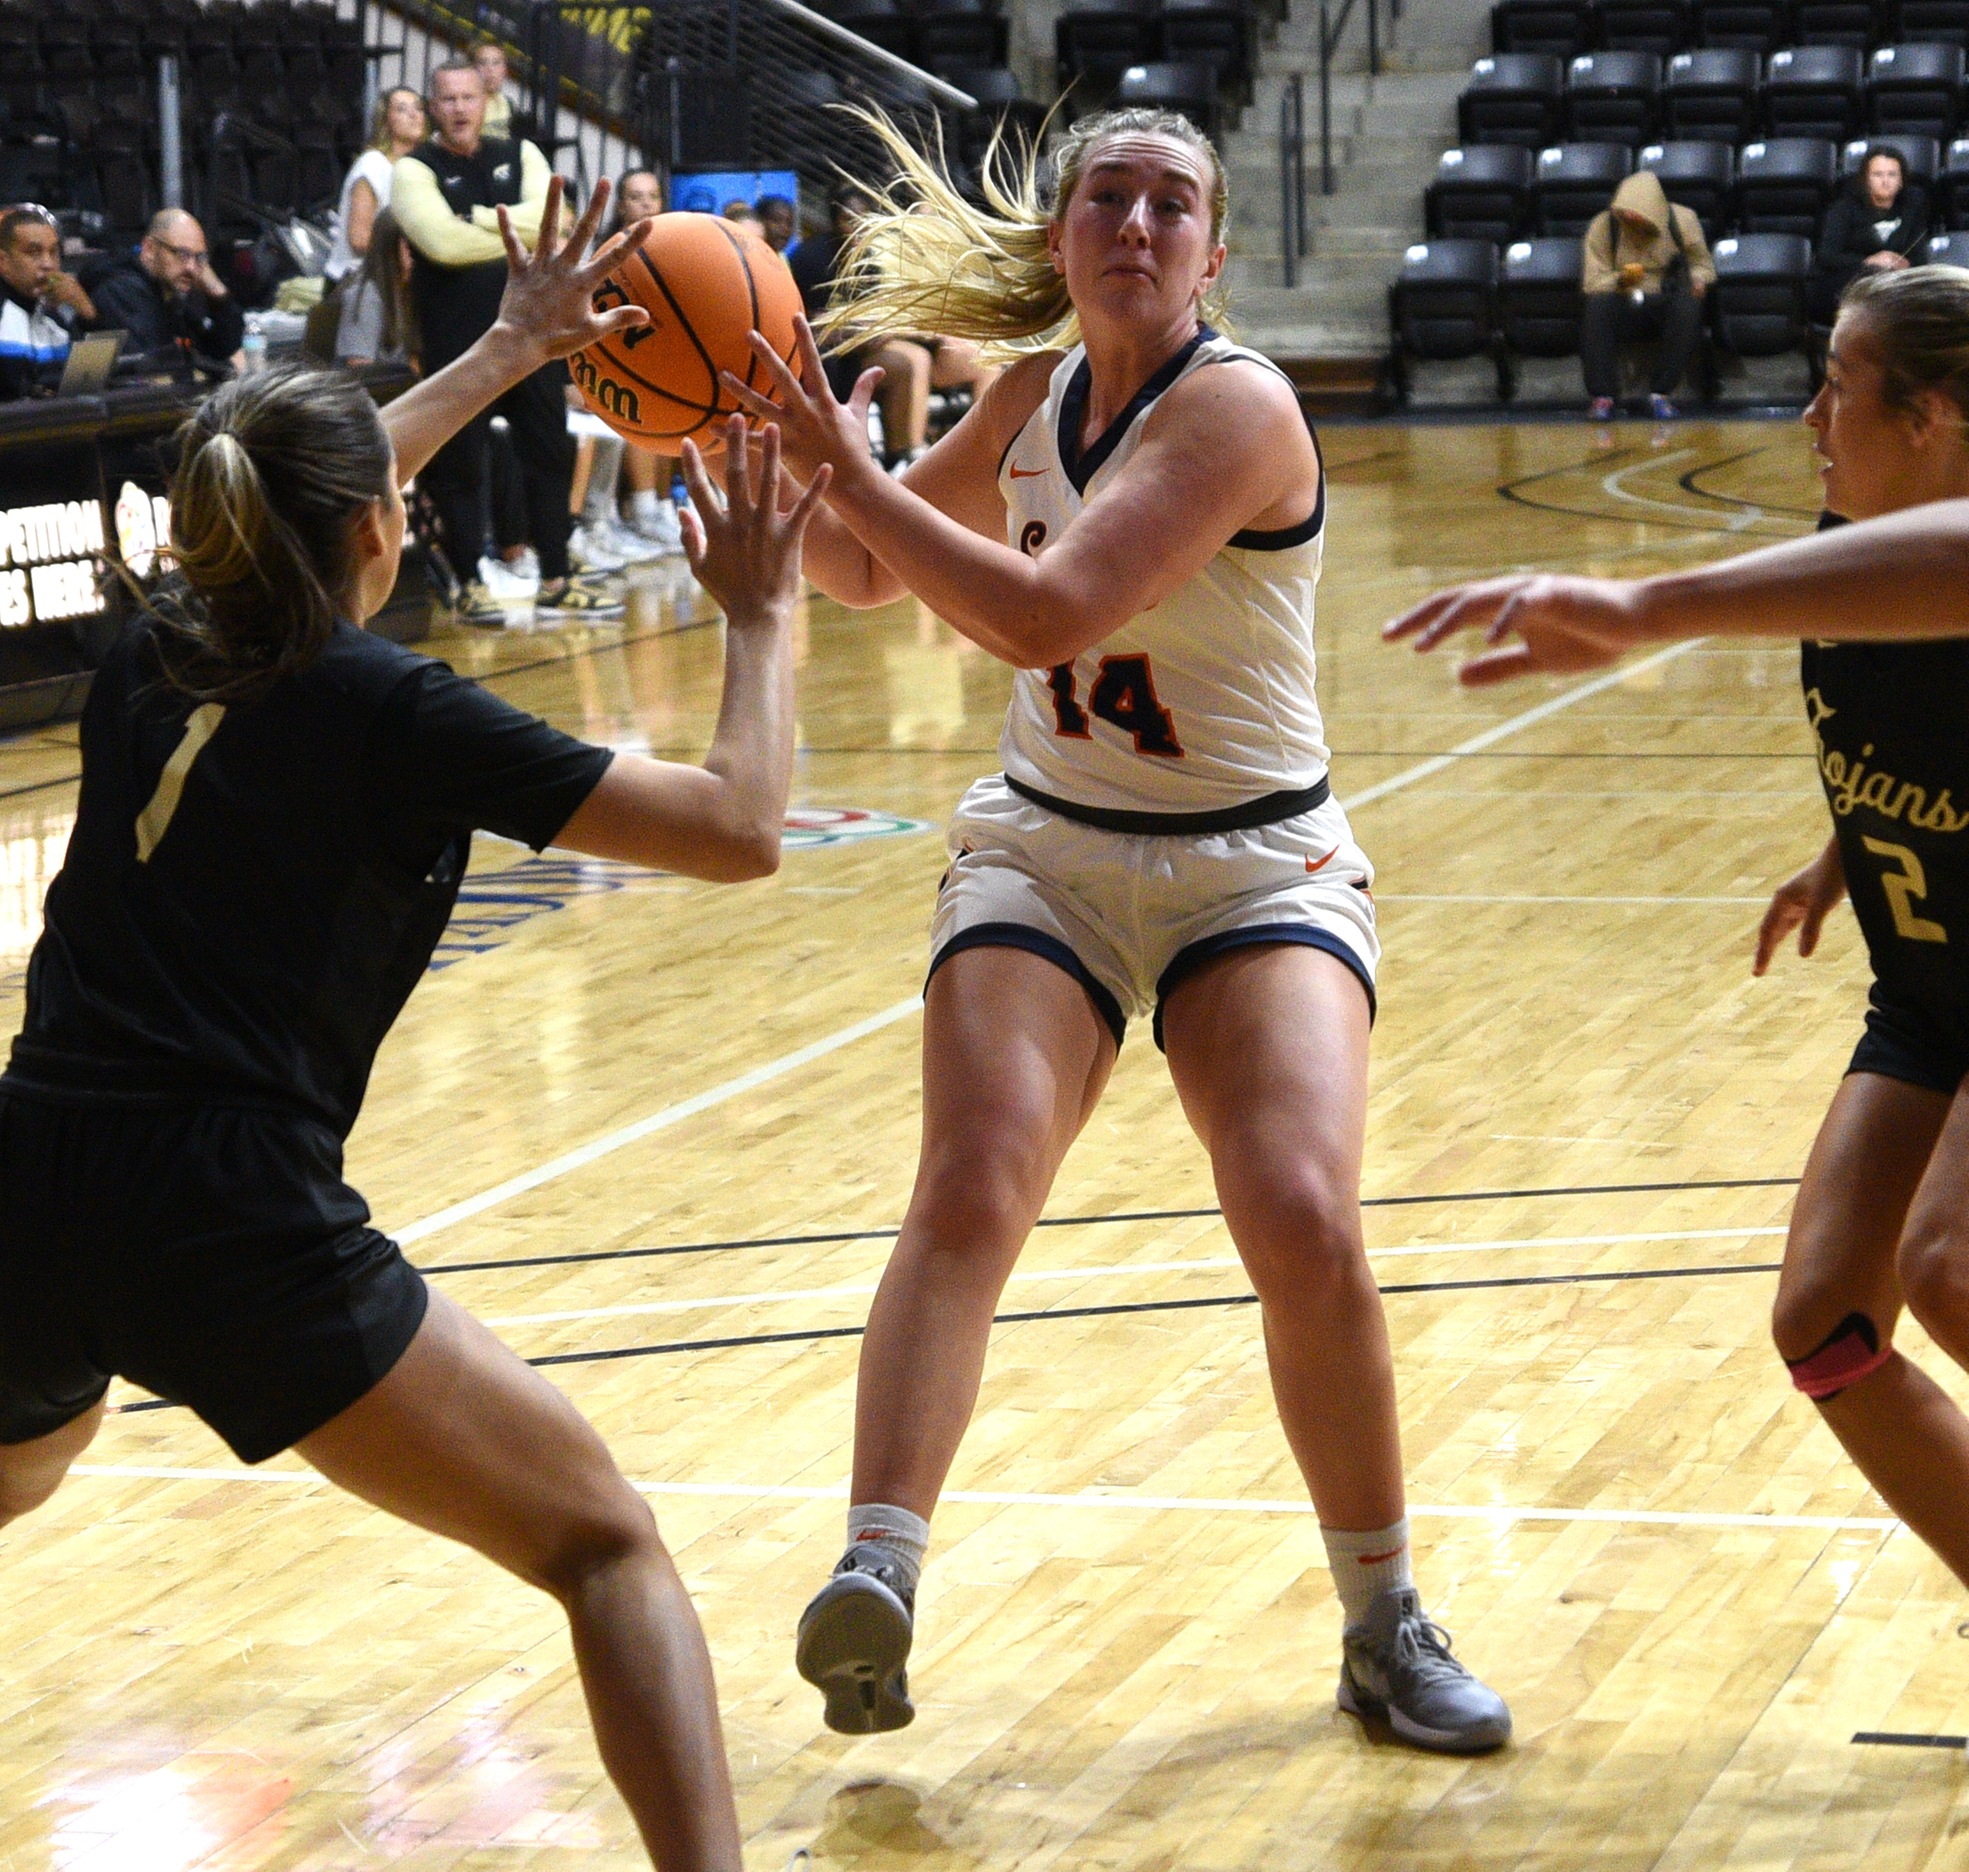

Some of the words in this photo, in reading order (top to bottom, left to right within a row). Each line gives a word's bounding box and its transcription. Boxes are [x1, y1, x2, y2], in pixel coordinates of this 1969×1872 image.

[1046, 652, 1186, 759] 14
[134, 702, 227, 865] 1
[1860, 834, 1948, 944] 2
